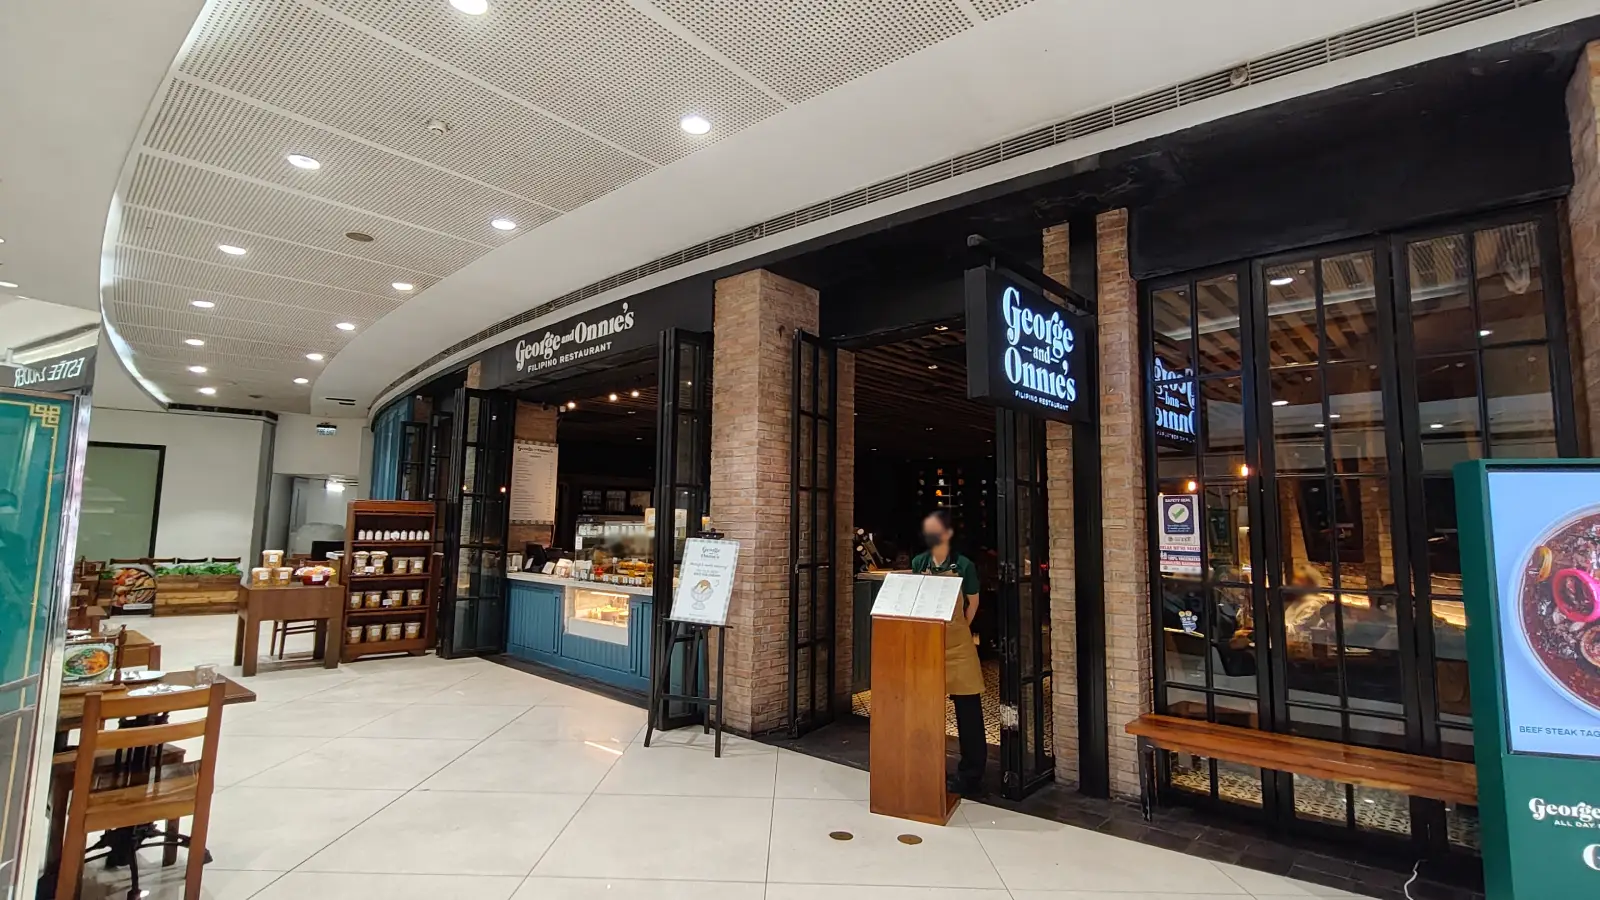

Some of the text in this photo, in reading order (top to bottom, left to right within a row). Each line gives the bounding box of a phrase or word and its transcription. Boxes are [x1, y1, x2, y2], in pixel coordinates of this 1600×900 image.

[1003, 286, 1074, 359] George
[515, 302, 634, 372] George and Onnie's
[527, 341, 612, 373] FILIPINO RESTAURANT
[1033, 345, 1051, 364] and
[1004, 346, 1076, 402] Onnie's
[1015, 389, 1069, 411] FILIPINO RESTAURANT
[1519, 725, 1543, 734] BEEF
[1544, 727, 1577, 736] STEAK
[1528, 797, 1600, 823] George
[1554, 819, 1573, 827] ALL
